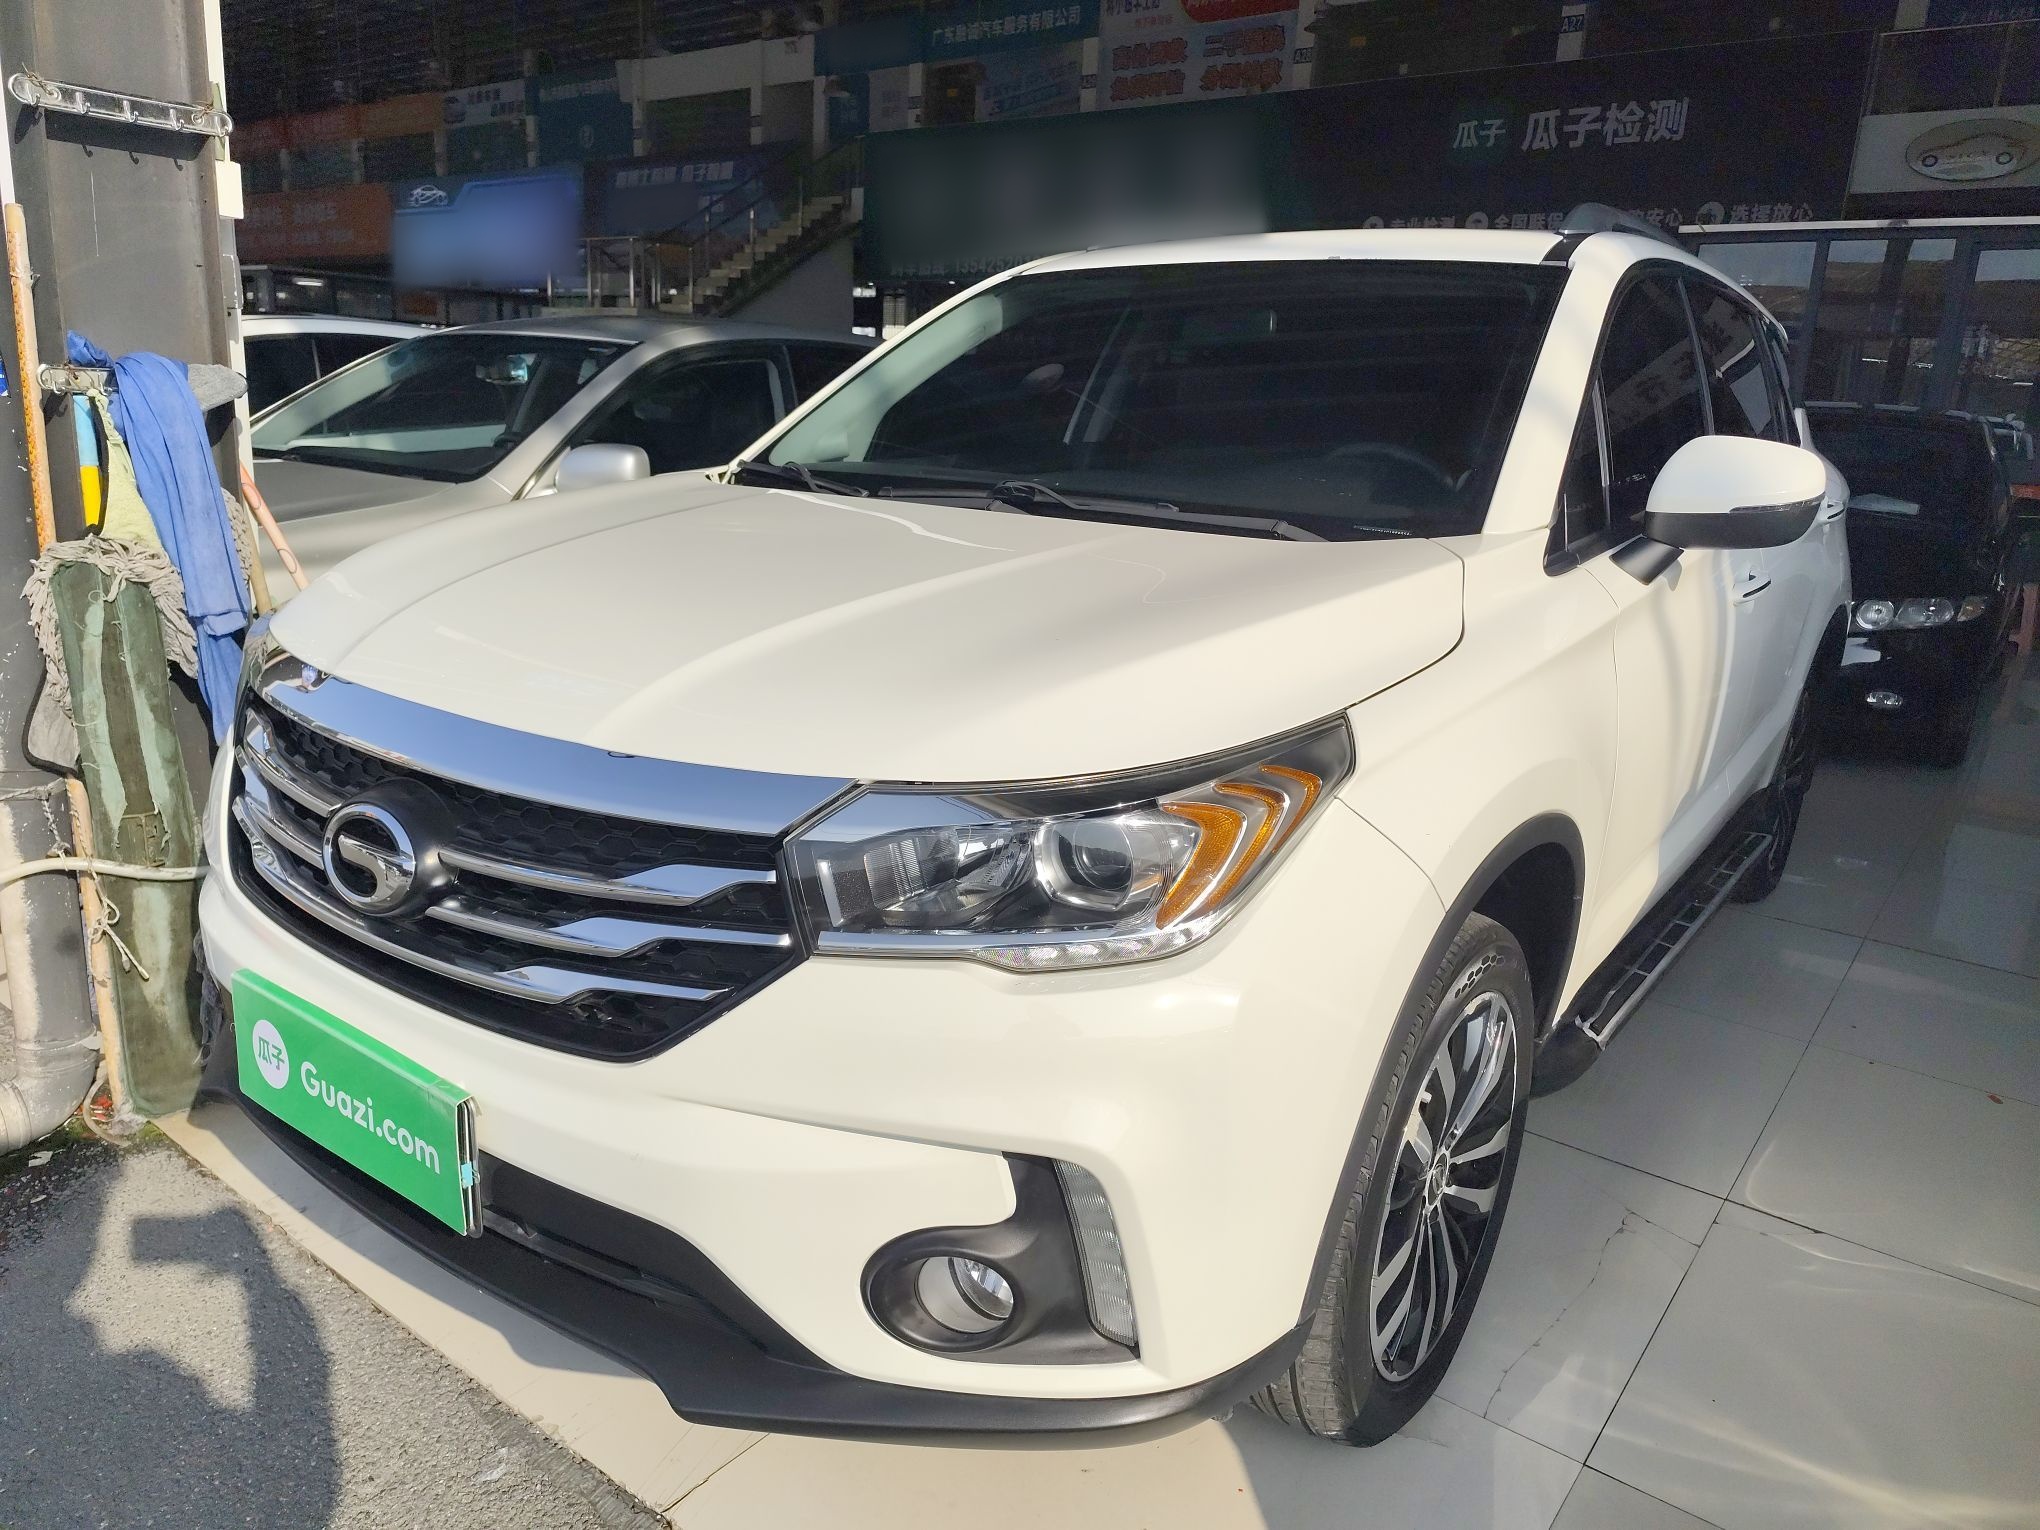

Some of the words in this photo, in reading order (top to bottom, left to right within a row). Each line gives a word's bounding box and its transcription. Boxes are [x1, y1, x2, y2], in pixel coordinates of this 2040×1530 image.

[1561, 16, 1583, 33] A27
[1453, 120, 1506, 149] 瓜子
[1521, 97, 1690, 151] 瓜子检测
[258, 1036, 285, 1070] 瓜子
[301, 1061, 440, 1174] Guazi.com
